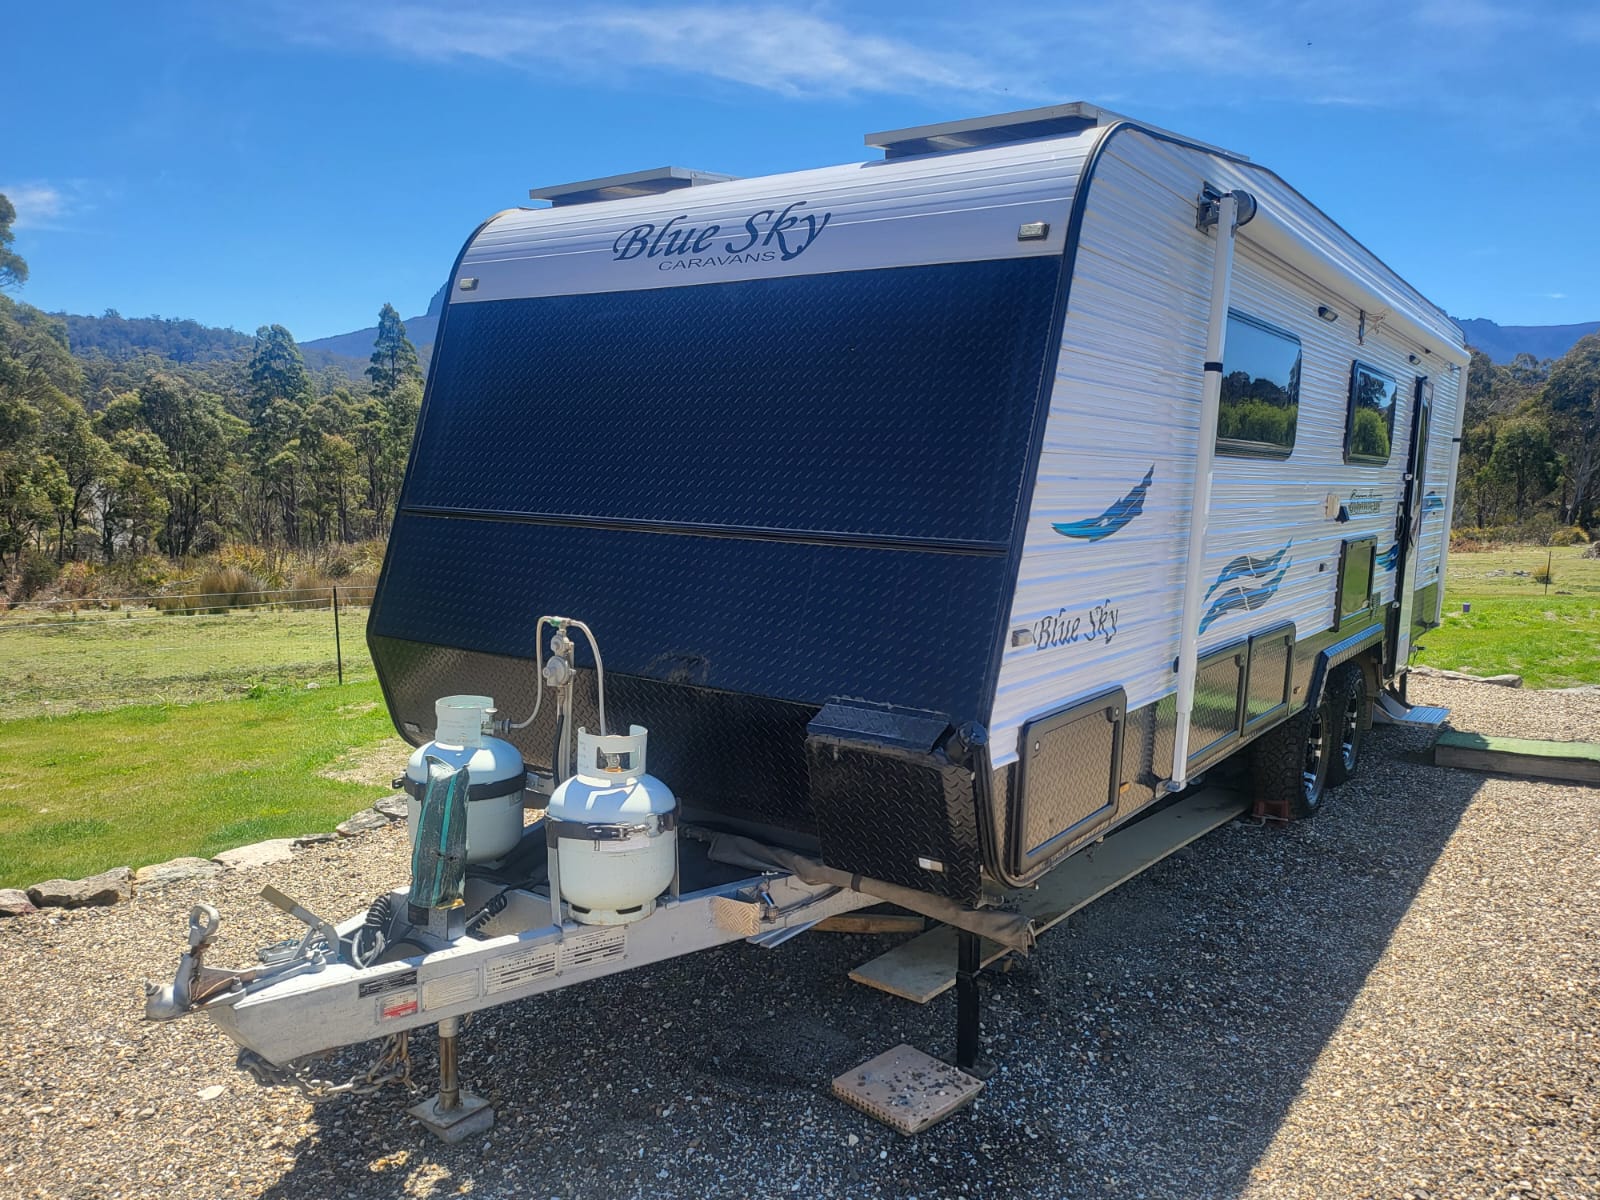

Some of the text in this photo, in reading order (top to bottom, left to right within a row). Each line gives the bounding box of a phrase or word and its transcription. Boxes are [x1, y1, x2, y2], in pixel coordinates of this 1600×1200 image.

[612, 200, 832, 262] Blue Sky
[658, 251, 776, 271] CARAVANS
[1032, 598, 1119, 651] Blue Sky
